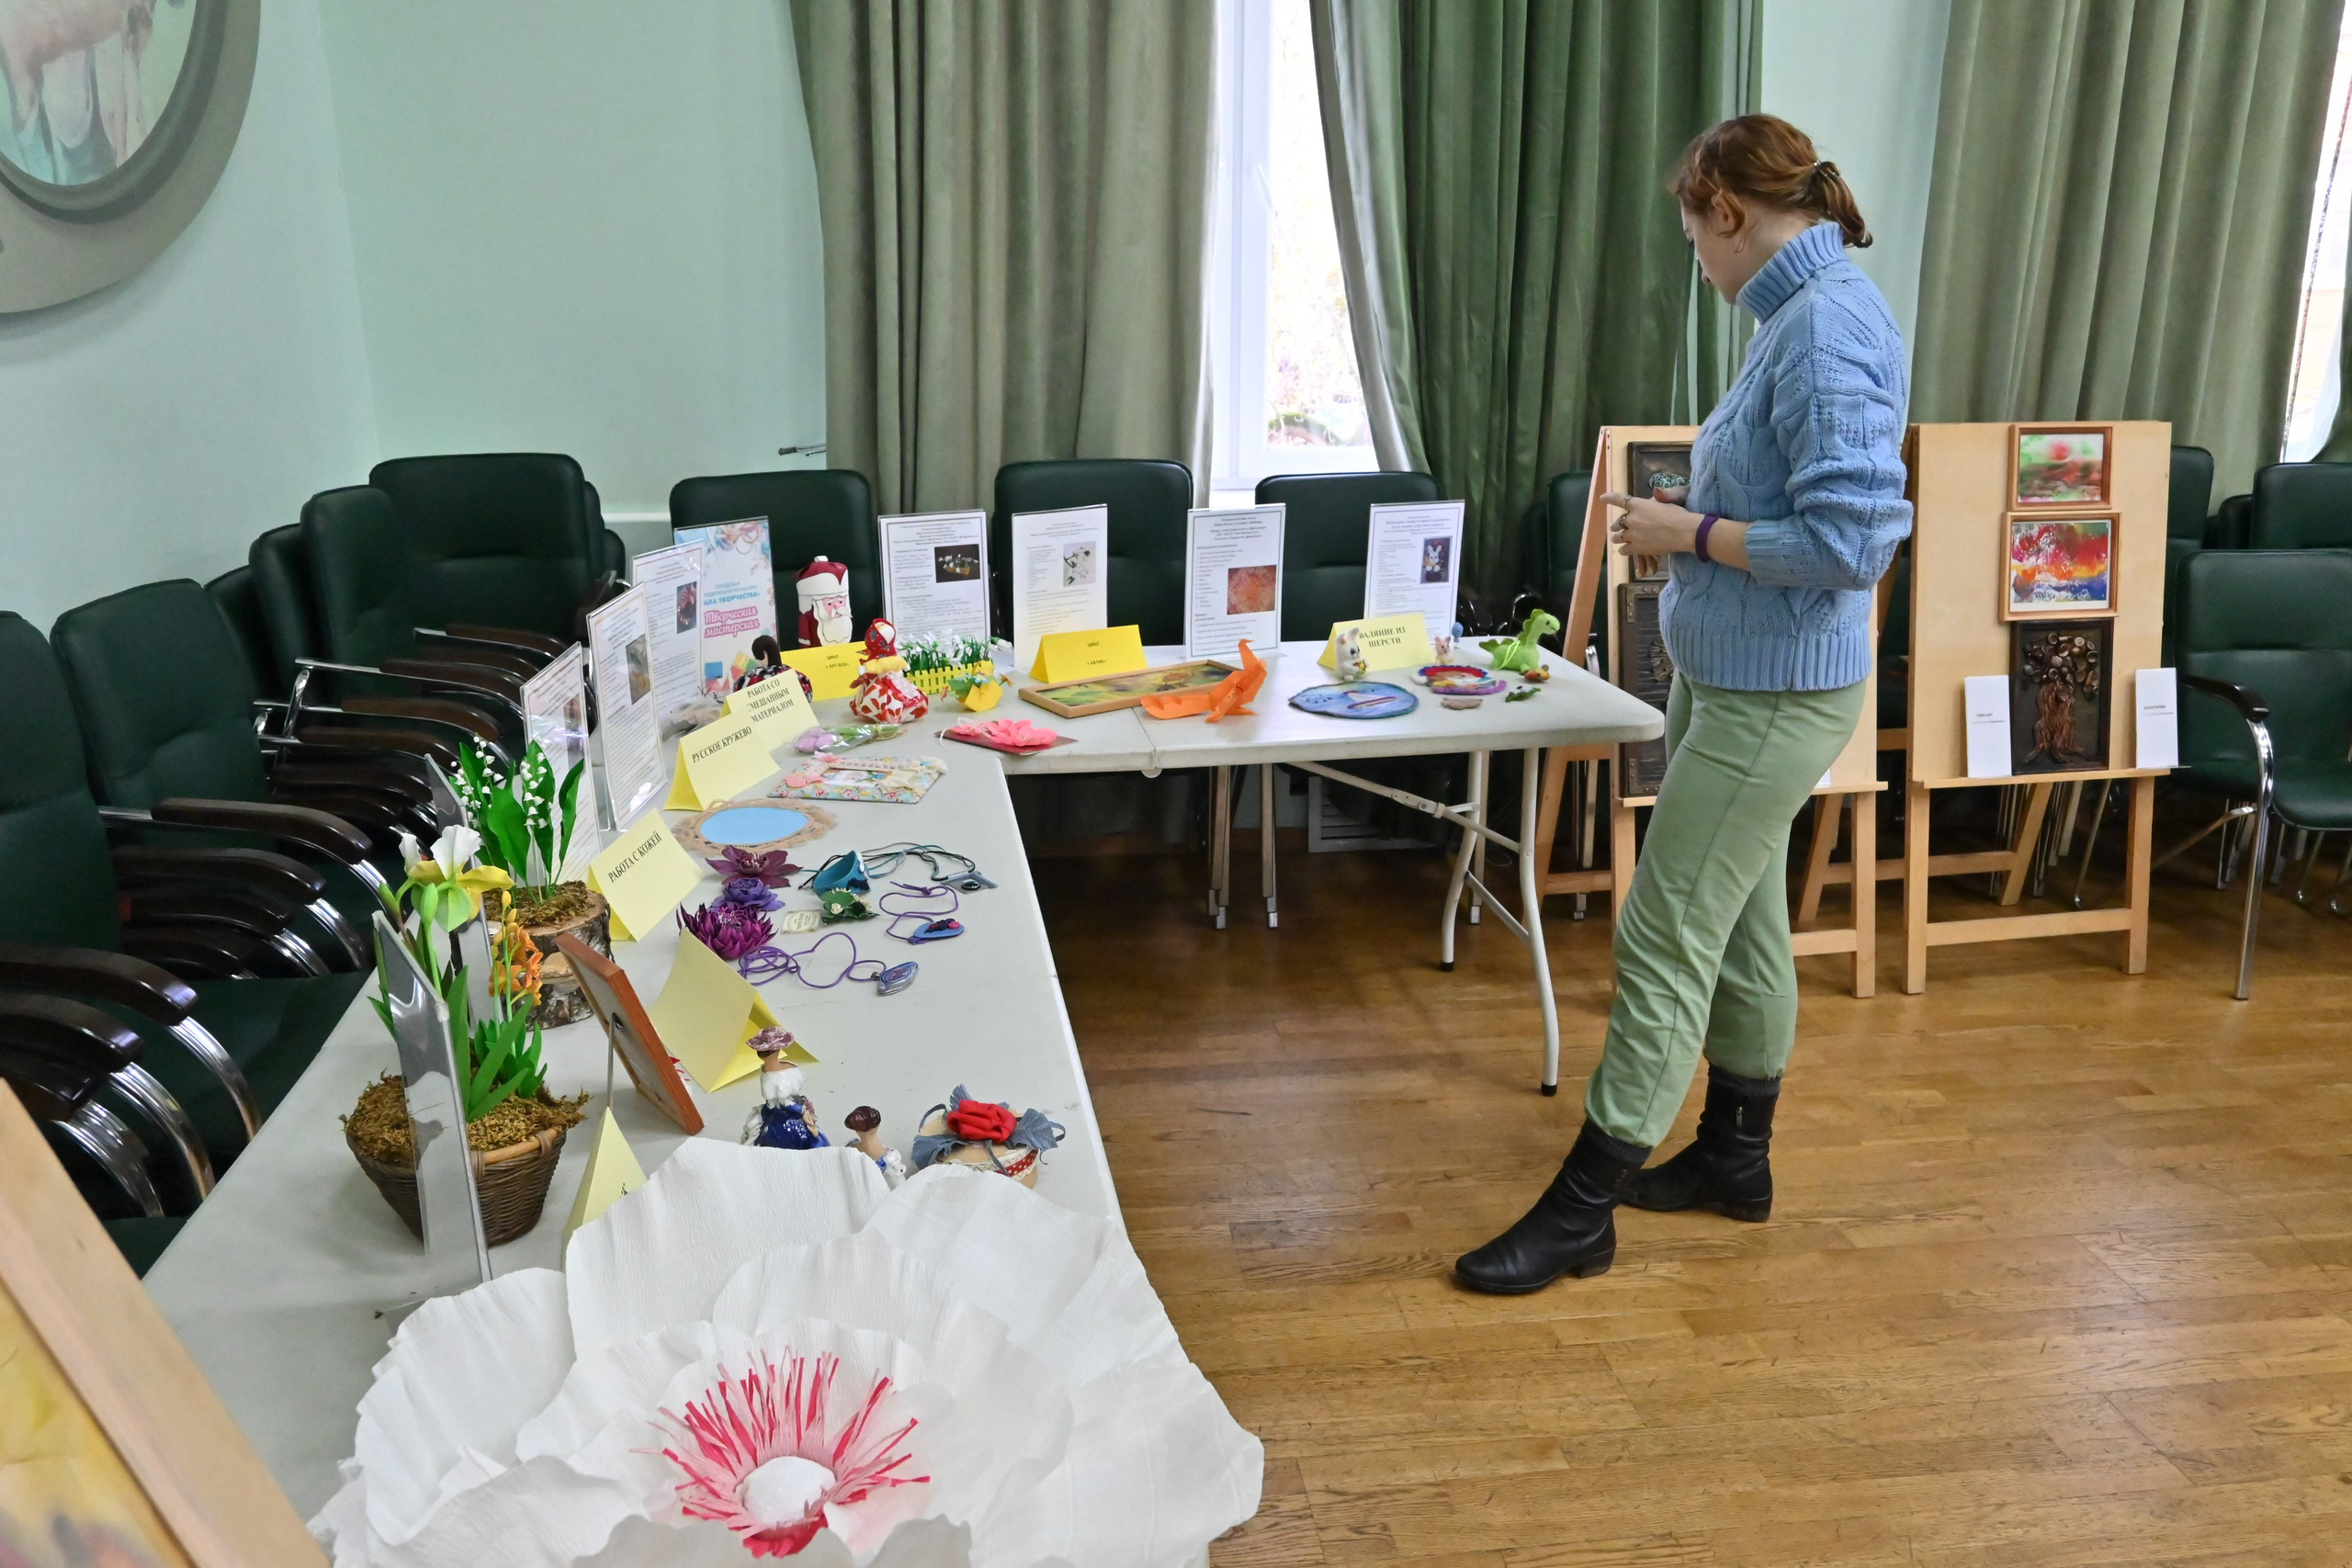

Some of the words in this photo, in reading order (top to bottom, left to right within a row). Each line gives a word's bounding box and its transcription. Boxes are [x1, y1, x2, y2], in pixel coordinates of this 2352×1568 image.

[704, 606, 758, 626] Творческая
[705, 619, 761, 638] мастерская
[1359, 628, 1395, 639] ВАЛЯНИЕ
[1368, 637, 1401, 648] ШЕРСТИ
[746, 682, 771, 698] РАБОТА
[771, 679, 780, 689] СО
[751, 699, 795, 723] МАТЕРИАЛОМ
[692, 740, 722, 763] РУССКОЕ
[722, 726, 752, 748] КРУЖЕВО
[607, 857, 634, 883] РАБОТА
[632, 851, 640, 862] С
[638, 830, 662, 857] КОЖЕЙ
